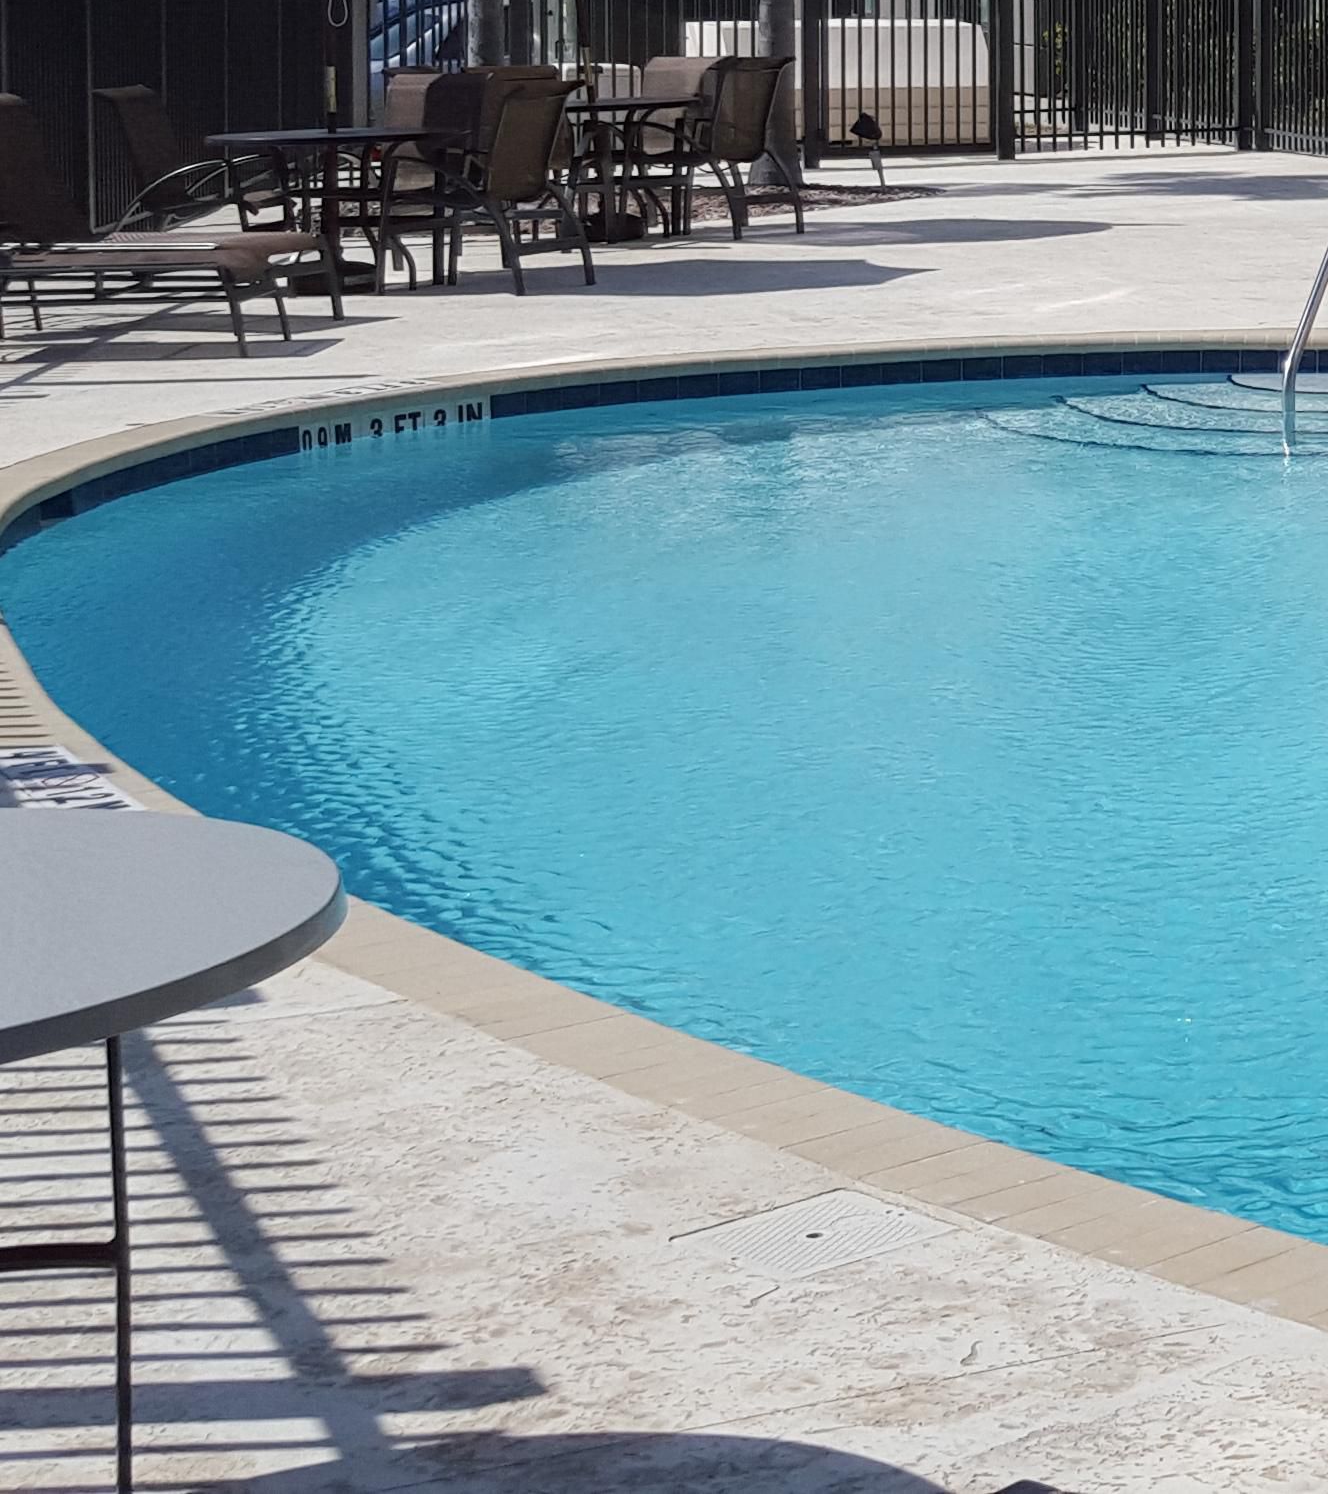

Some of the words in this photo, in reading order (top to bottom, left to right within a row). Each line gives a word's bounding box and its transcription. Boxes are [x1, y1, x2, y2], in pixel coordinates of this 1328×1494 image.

[335, 422, 352, 444] M
[370, 418, 383, 438] 3
[394, 410, 421, 434] FT
[458, 401, 483, 423] IN
